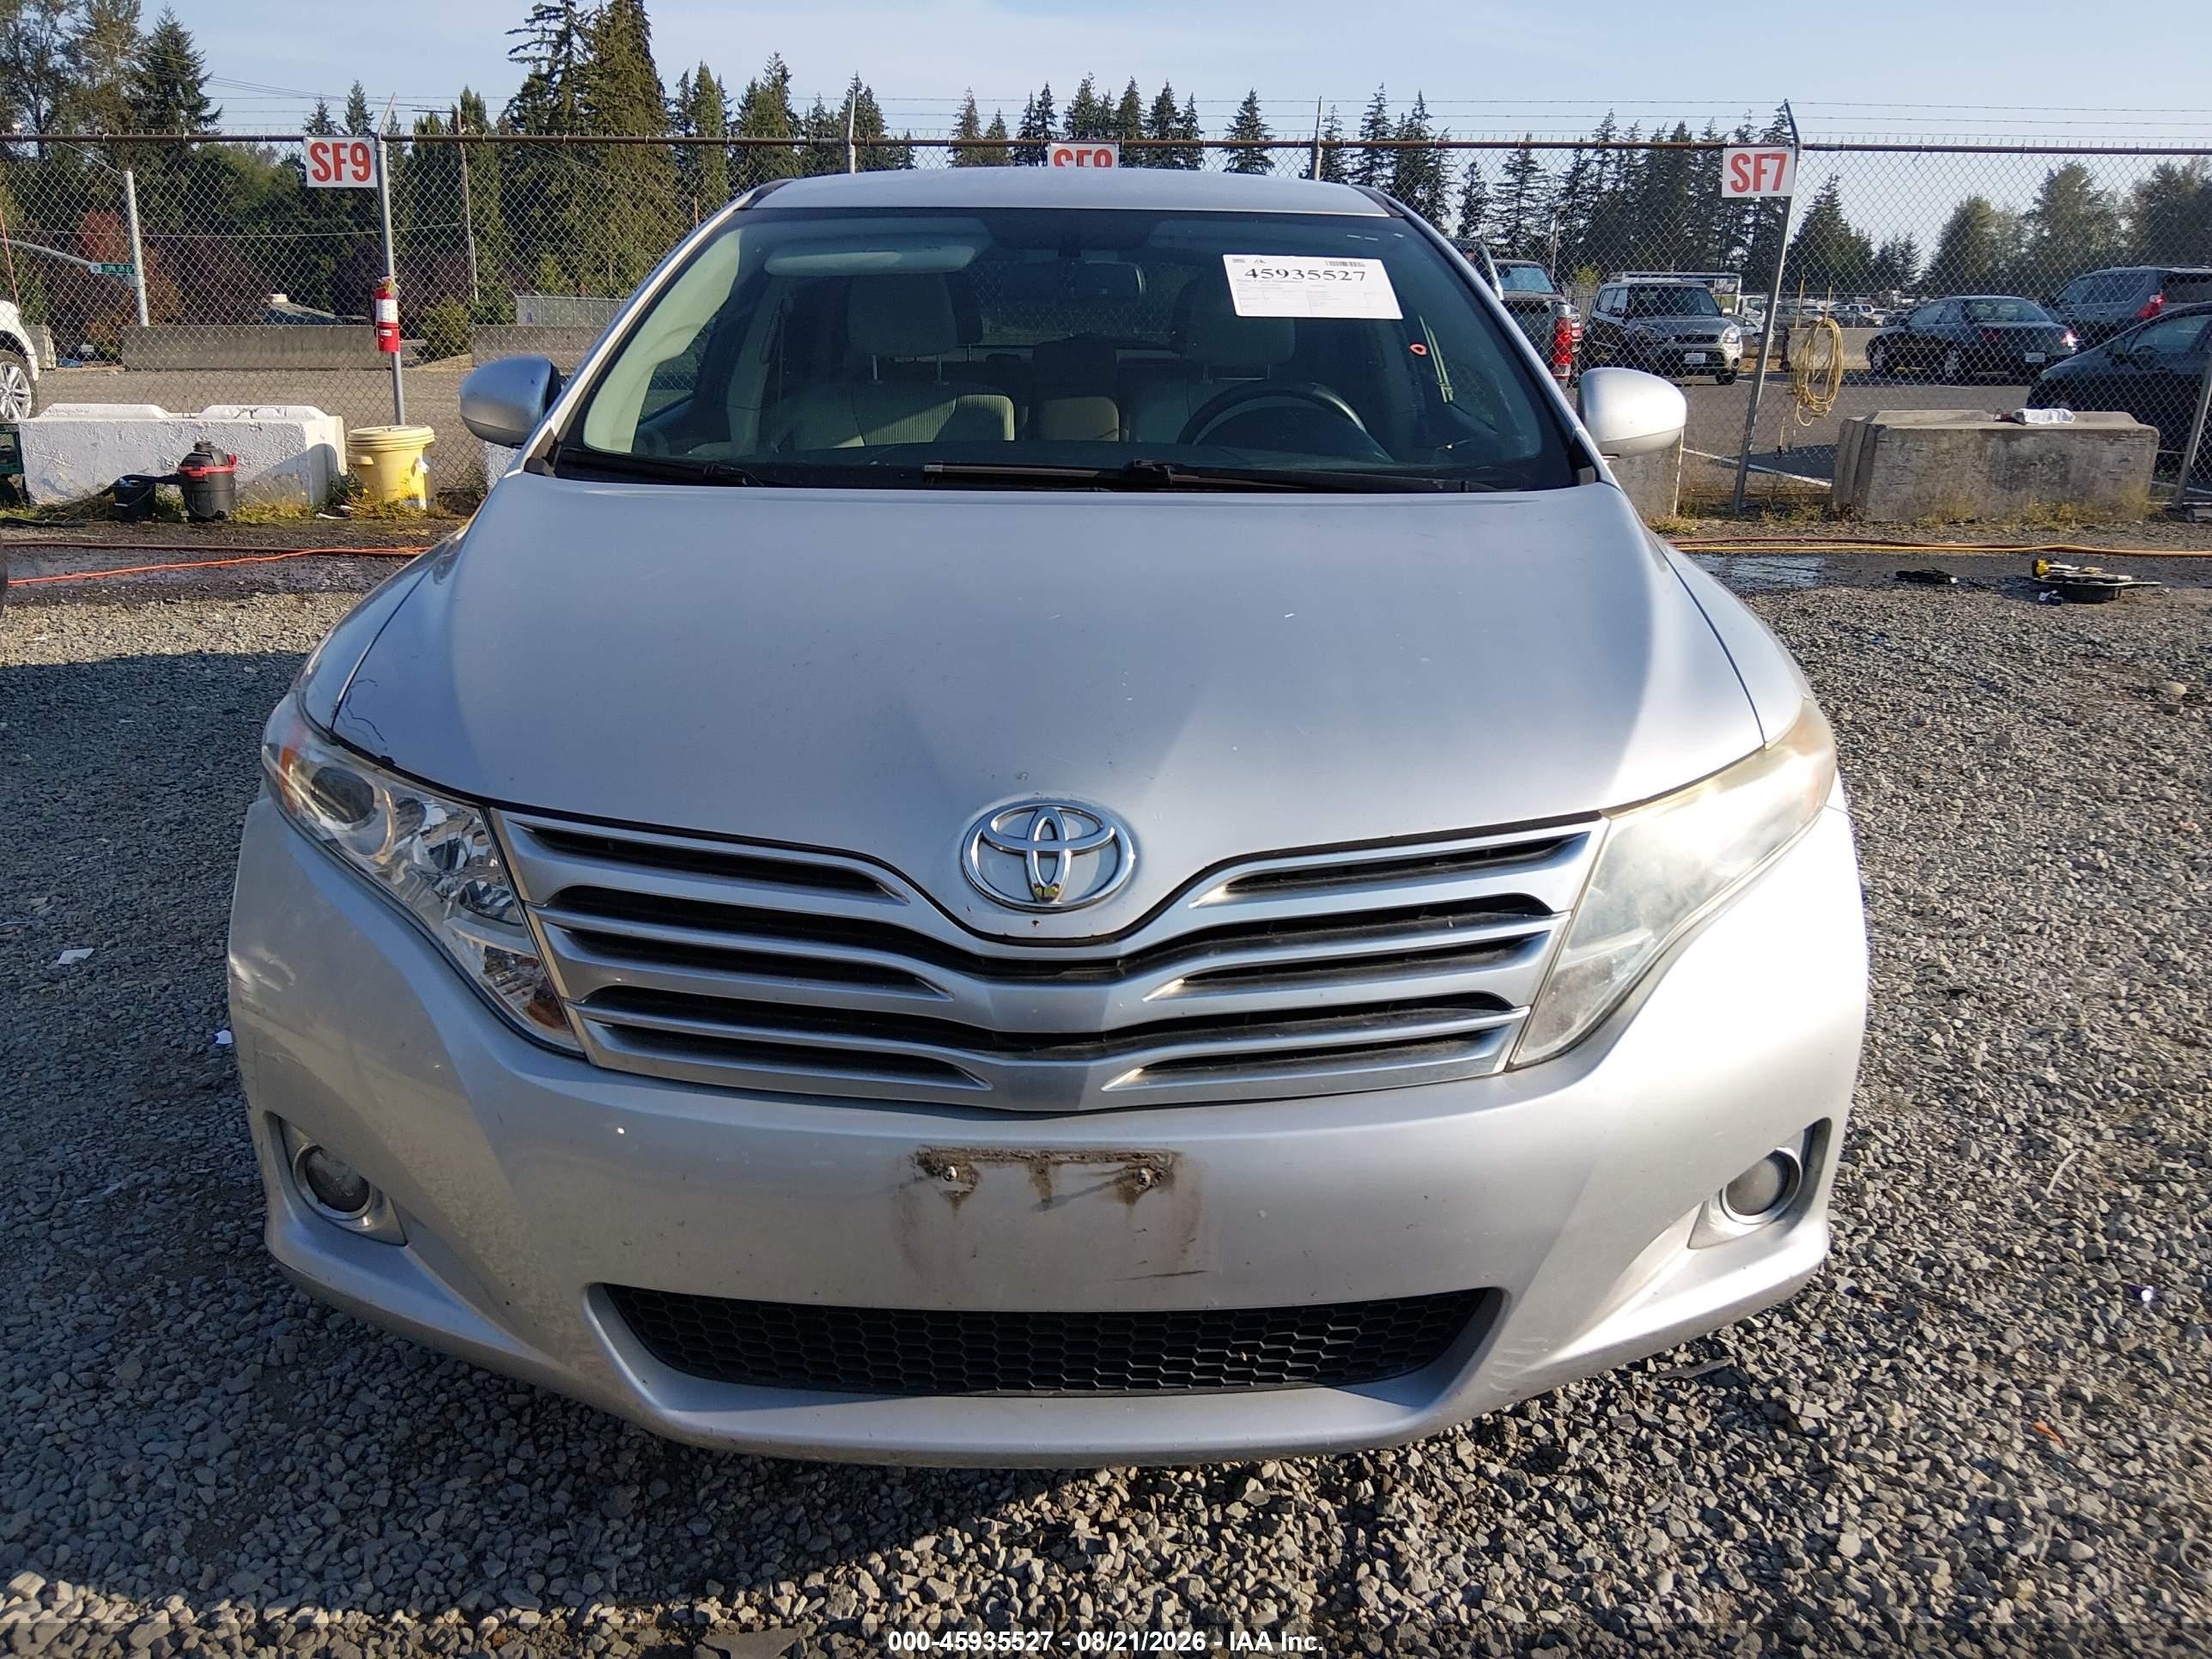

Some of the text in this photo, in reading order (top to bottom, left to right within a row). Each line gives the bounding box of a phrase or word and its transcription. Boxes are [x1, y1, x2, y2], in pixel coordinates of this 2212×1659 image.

[310, 142, 371, 182] SF9
[1730, 153, 1787, 193] SF7
[1244, 268, 1366, 282] 45935527
